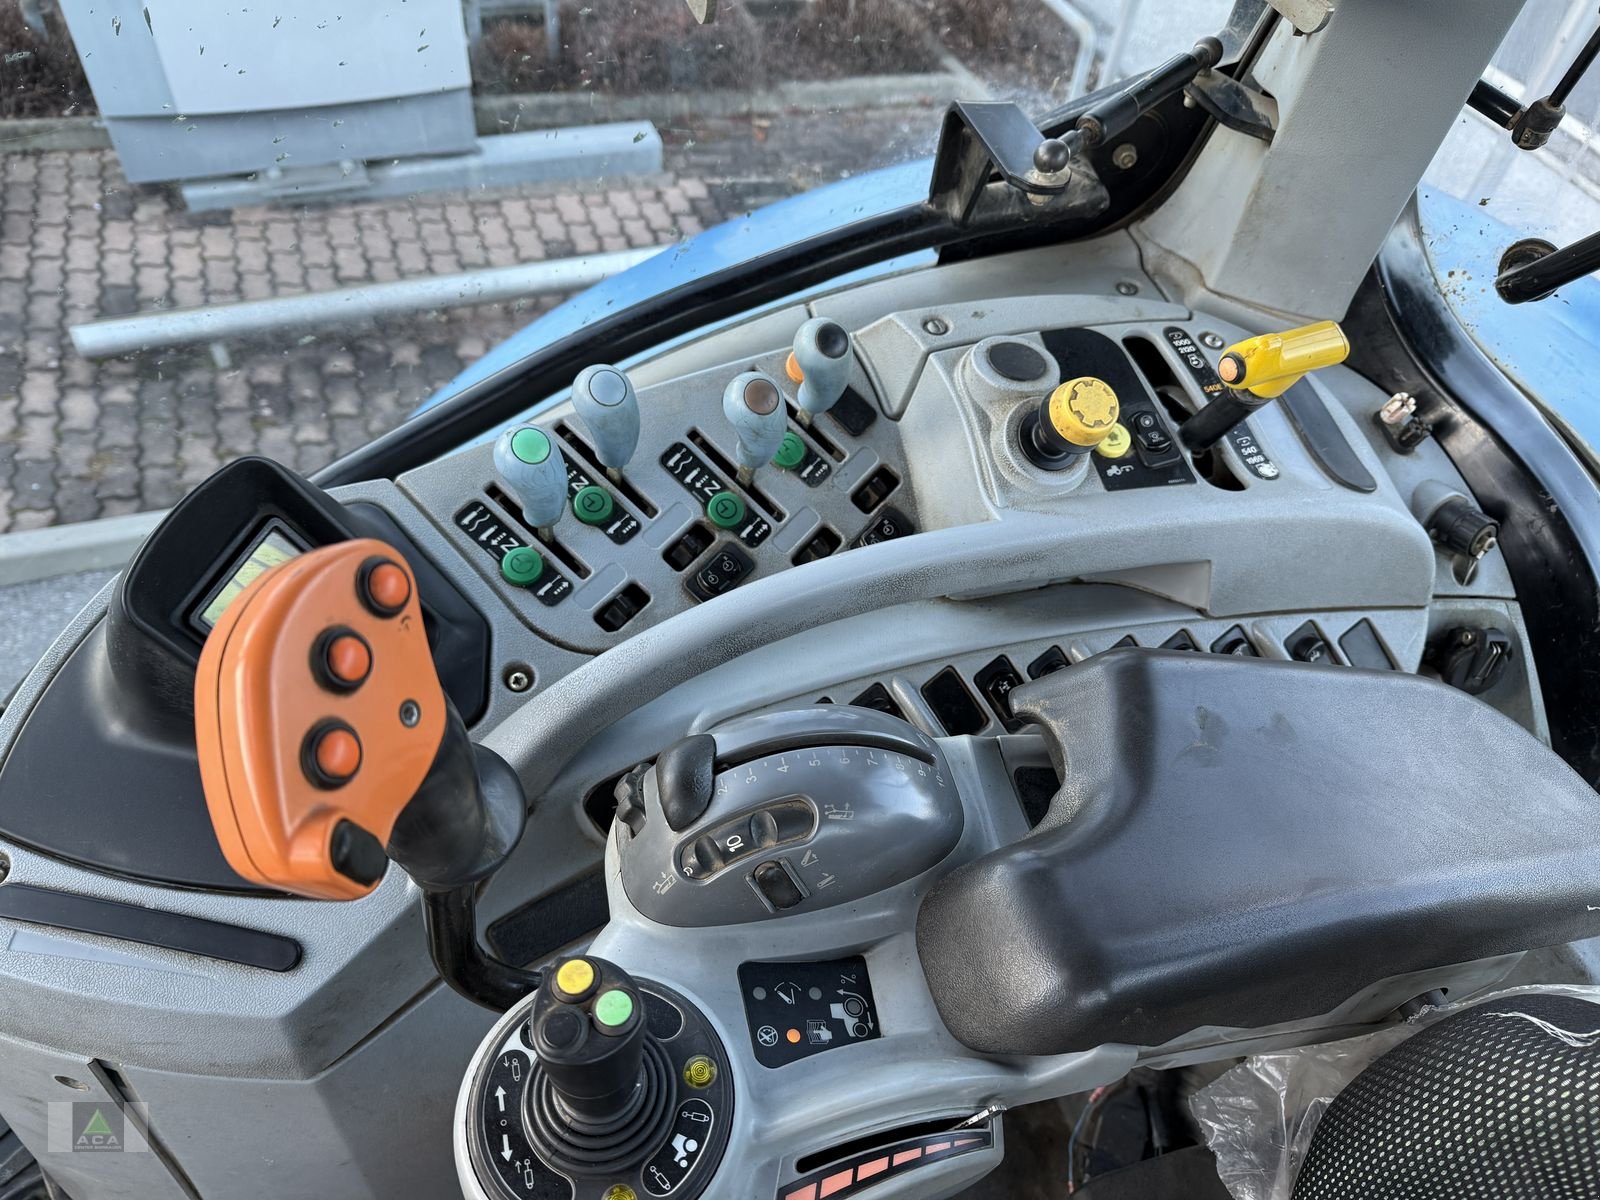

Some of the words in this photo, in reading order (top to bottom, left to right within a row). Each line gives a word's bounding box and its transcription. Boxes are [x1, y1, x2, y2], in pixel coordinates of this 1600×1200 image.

[1173, 338, 1191, 347] 1000
[1241, 445, 1257, 456] 540
[809, 759, 821, 767] 5
[866, 758, 878, 766] 7
[896, 762, 905, 771] 8
[776, 764, 789, 773] 4
[918, 769, 926, 777] 9
[745, 775, 757, 784] 3
[935, 775, 945, 788] 10
[717, 785, 728, 796] 2
[726, 835, 744, 852] 10
